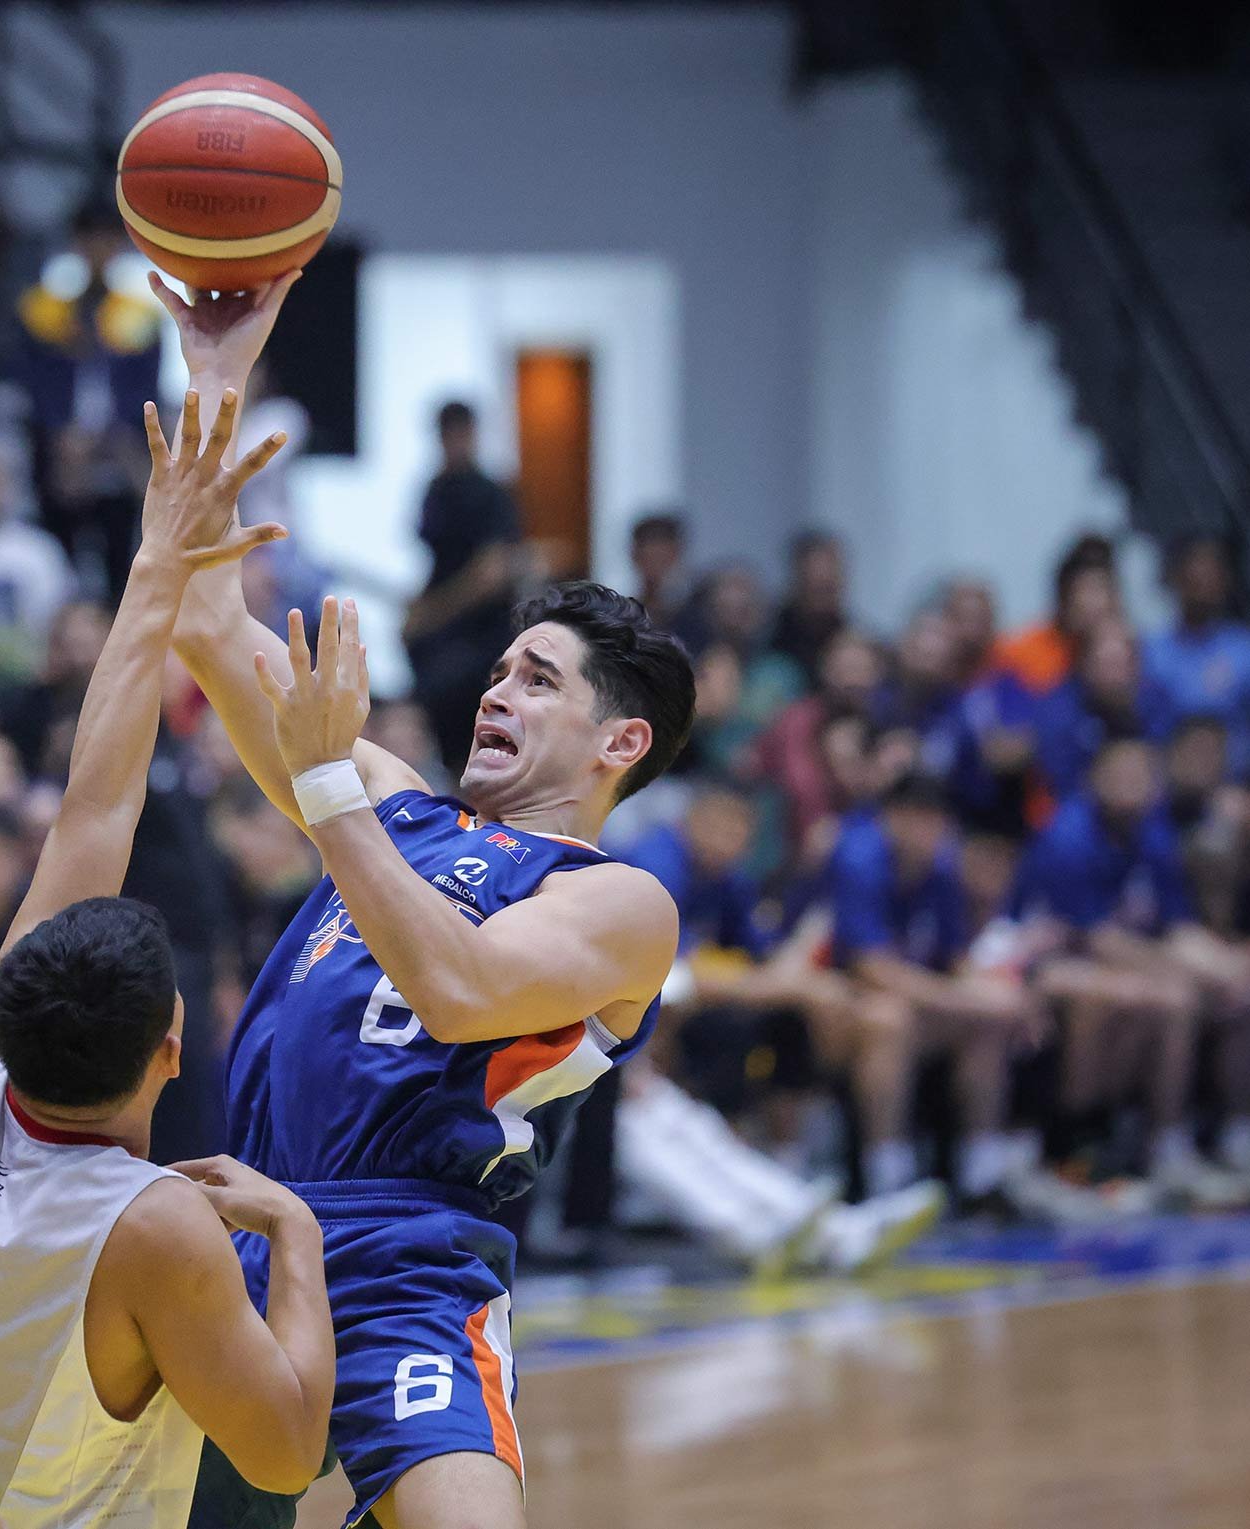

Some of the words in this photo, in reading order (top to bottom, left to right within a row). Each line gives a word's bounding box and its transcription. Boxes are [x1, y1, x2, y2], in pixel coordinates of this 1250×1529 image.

[197, 131, 247, 152] FIBA
[486, 832, 531, 864] PBA
[431, 874, 477, 904] MERALCO
[393, 1354, 454, 1422] 6
